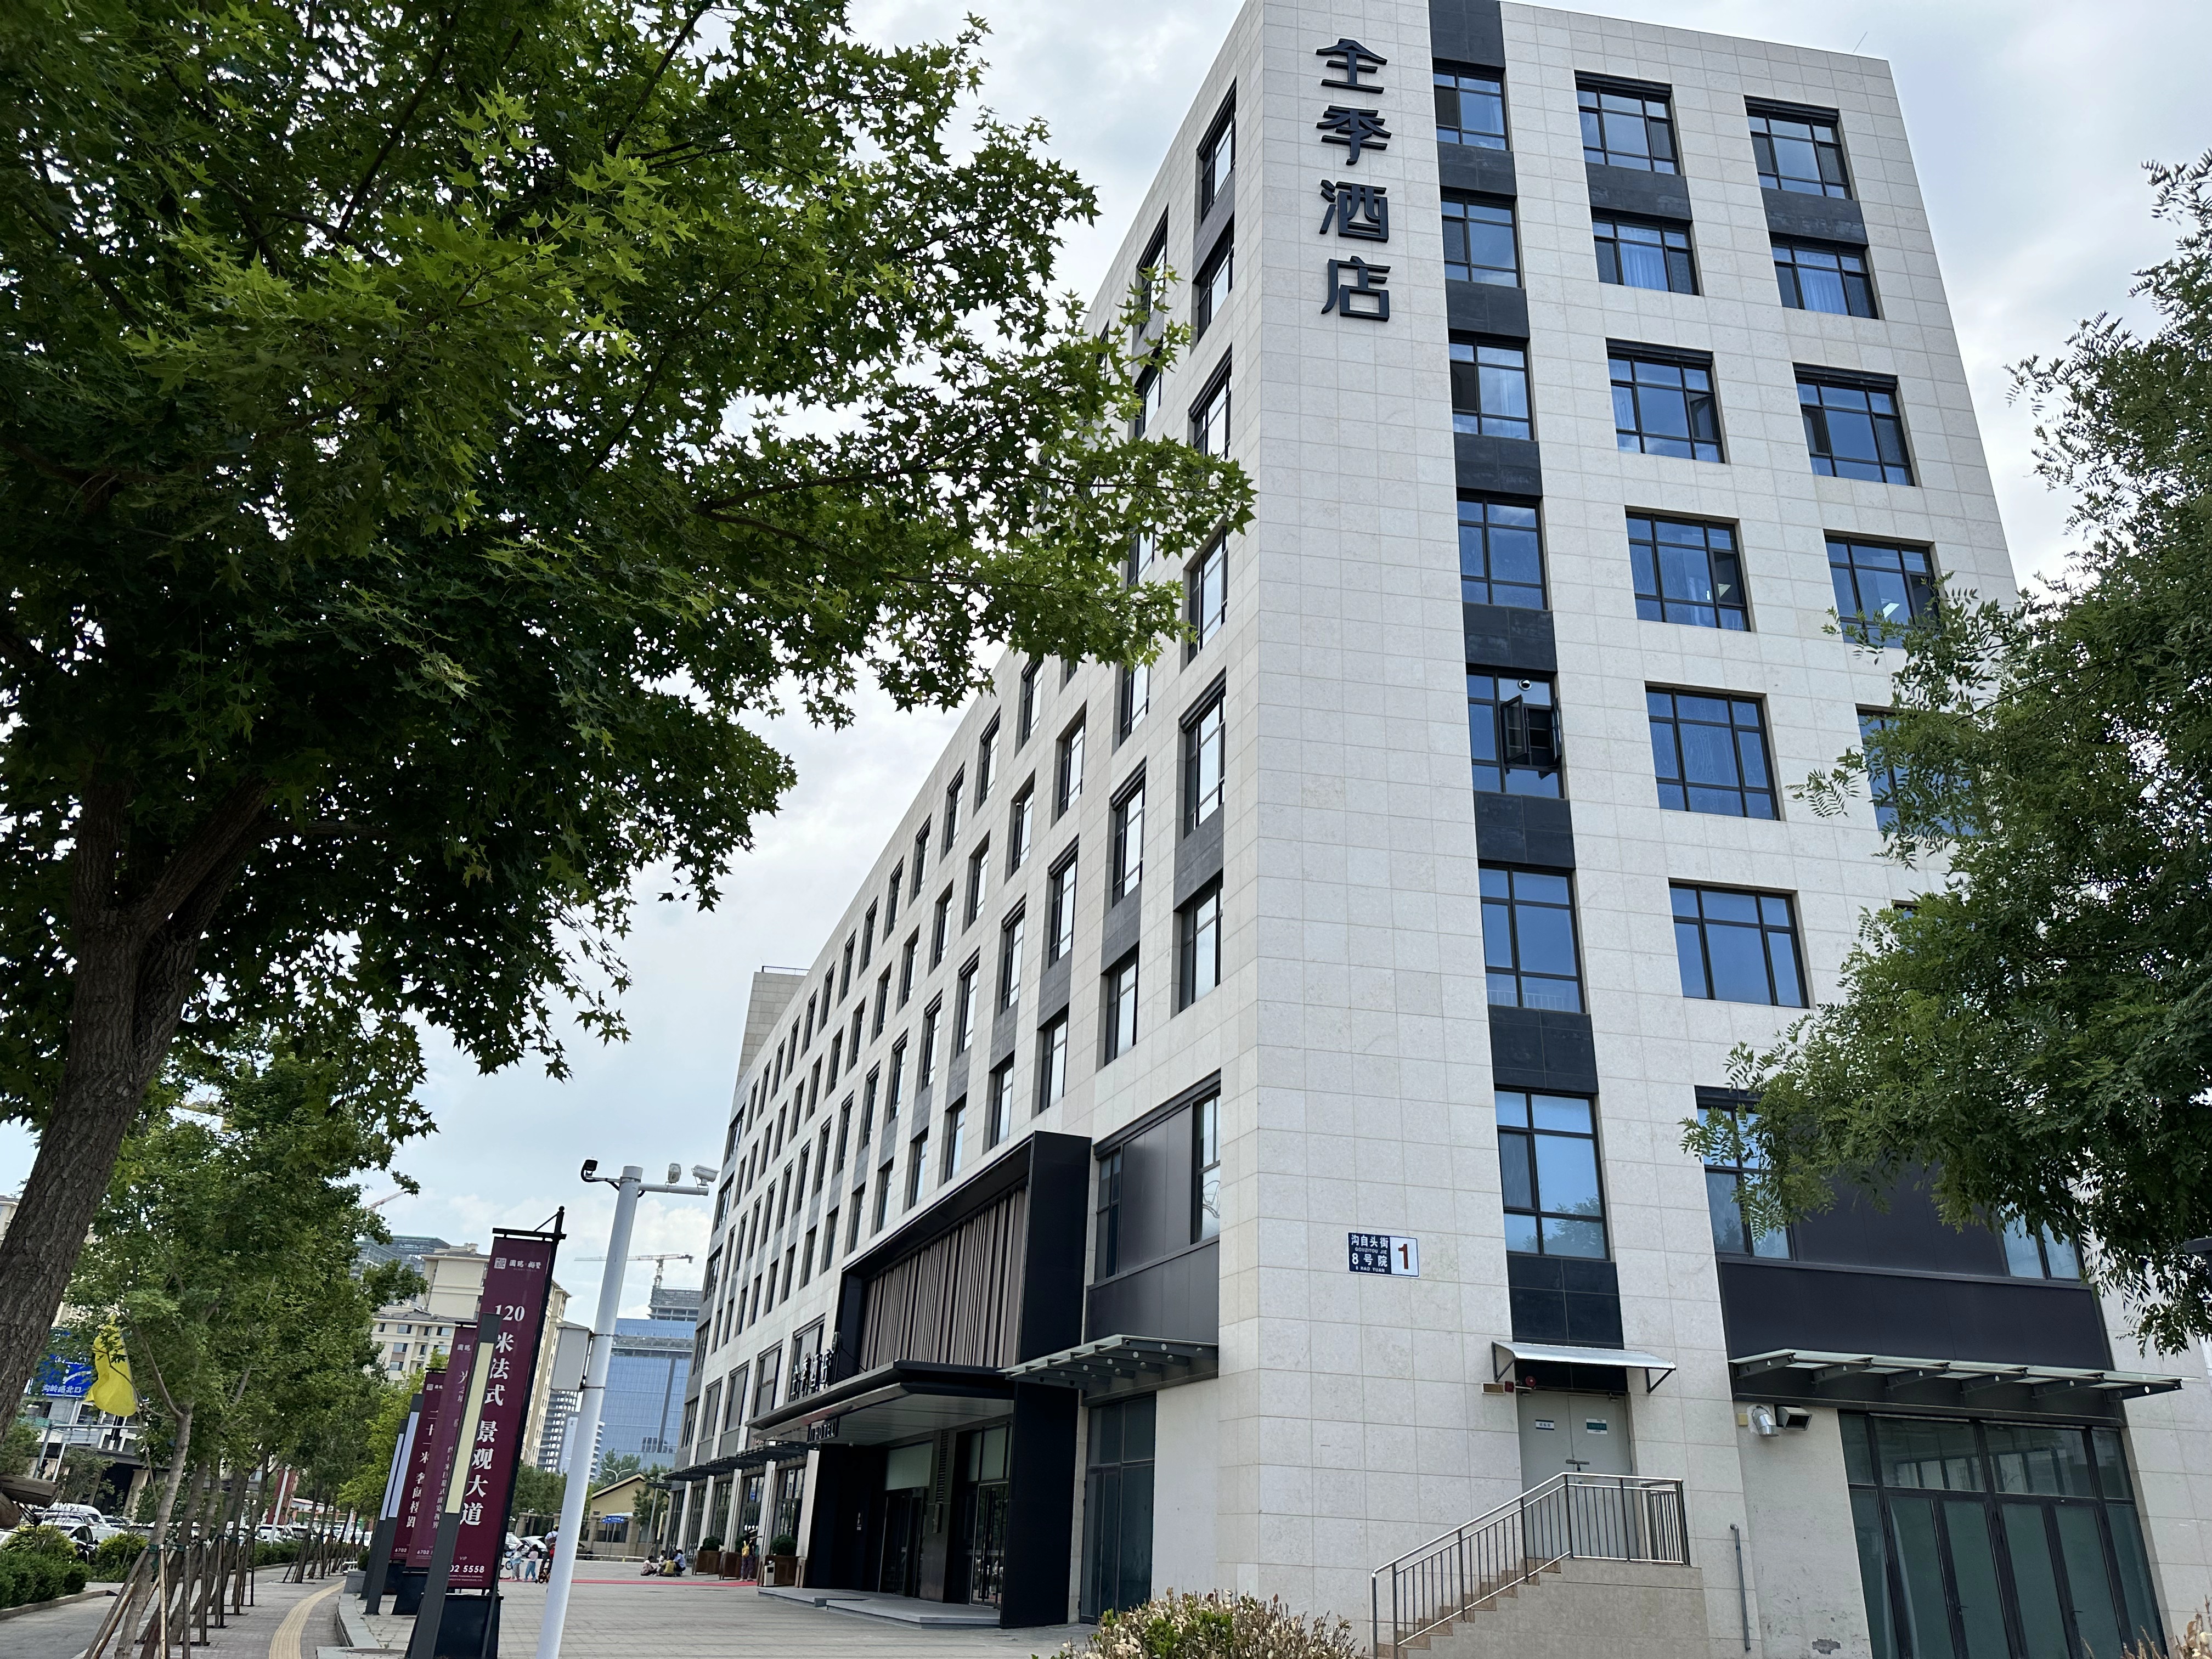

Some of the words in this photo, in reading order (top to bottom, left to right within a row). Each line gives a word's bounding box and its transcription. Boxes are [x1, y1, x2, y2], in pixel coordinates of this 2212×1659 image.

[1316, 38, 1392, 322] 全季酒店
[1351, 1234, 1389, 1248] 沟自头街
[1398, 1244, 1408, 1269] 1
[815, 1423, 834, 1441] HOTEL
